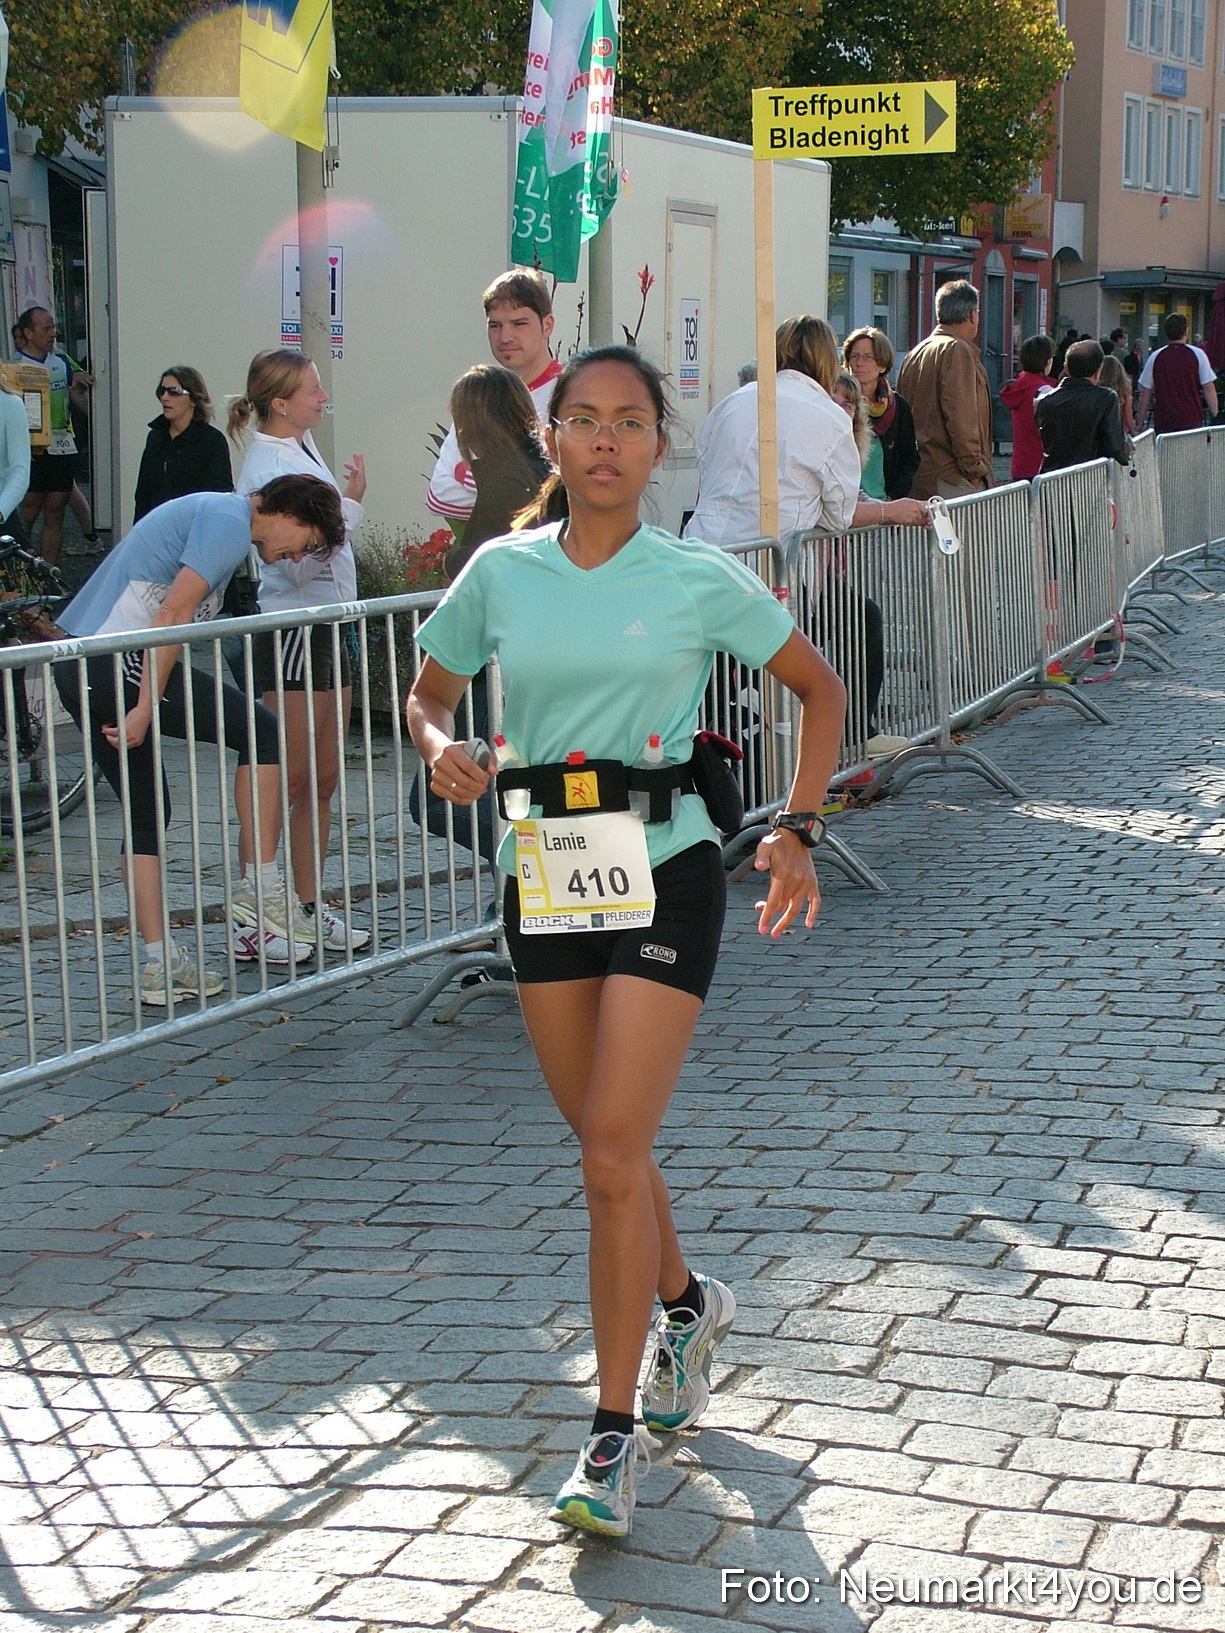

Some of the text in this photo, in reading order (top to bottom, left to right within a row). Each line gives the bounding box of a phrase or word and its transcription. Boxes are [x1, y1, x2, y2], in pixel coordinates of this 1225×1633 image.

[768, 91, 901, 121] Treffpunkt
[769, 123, 910, 151] Bladenight
[543, 830, 587, 851] Lanie
[522, 863, 531, 879] C
[567, 867, 631, 898] 410
[523, 914, 575, 929] BOCK
[605, 910, 652, 922] PFLEIDERER
